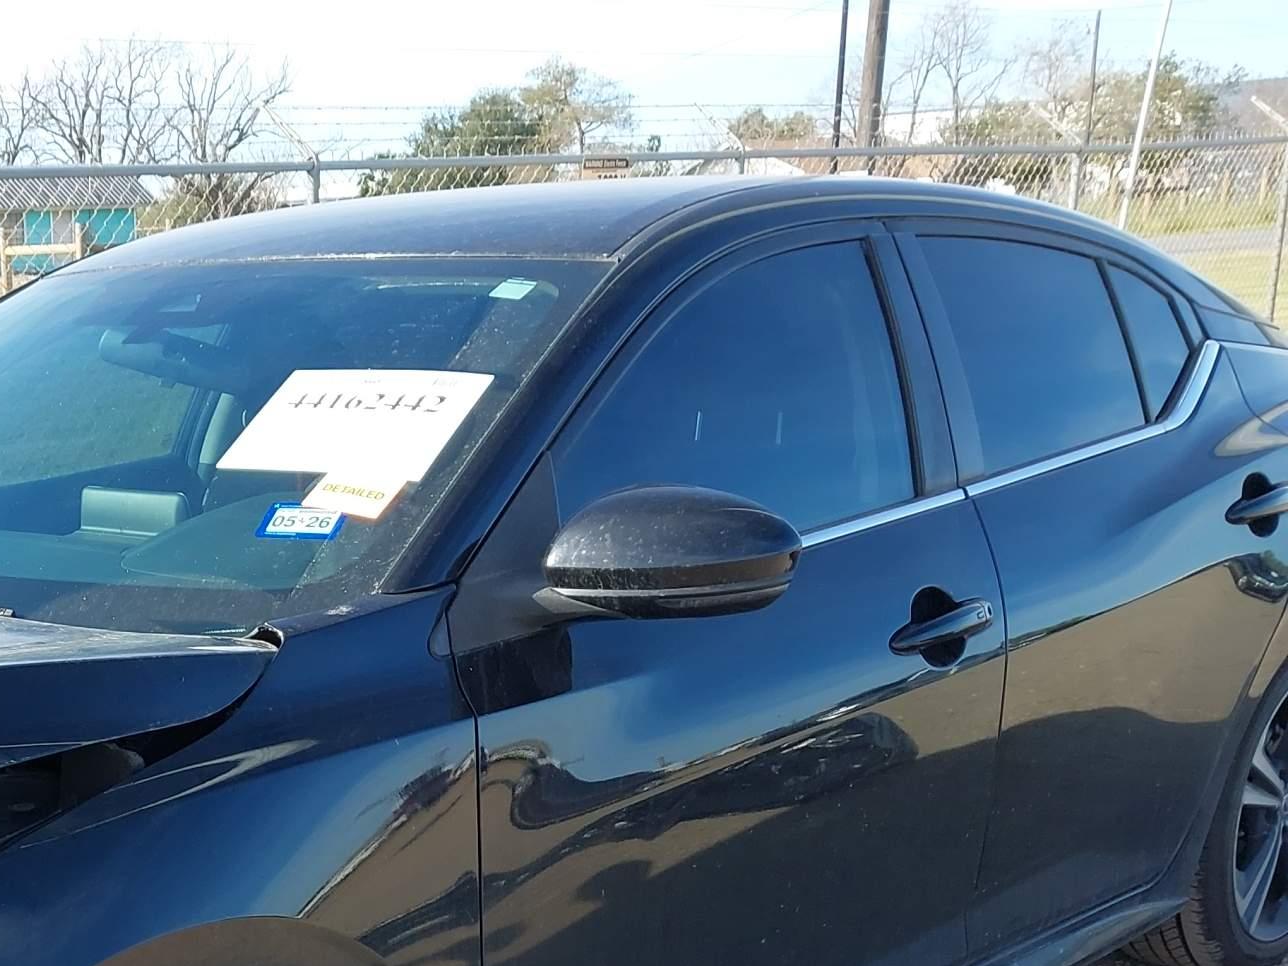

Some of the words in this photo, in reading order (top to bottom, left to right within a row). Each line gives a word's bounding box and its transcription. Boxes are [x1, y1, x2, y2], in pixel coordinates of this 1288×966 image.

[322, 483, 385, 500] DETAILED
[271, 515, 296, 528] 05
[305, 516, 332, 529] 26
